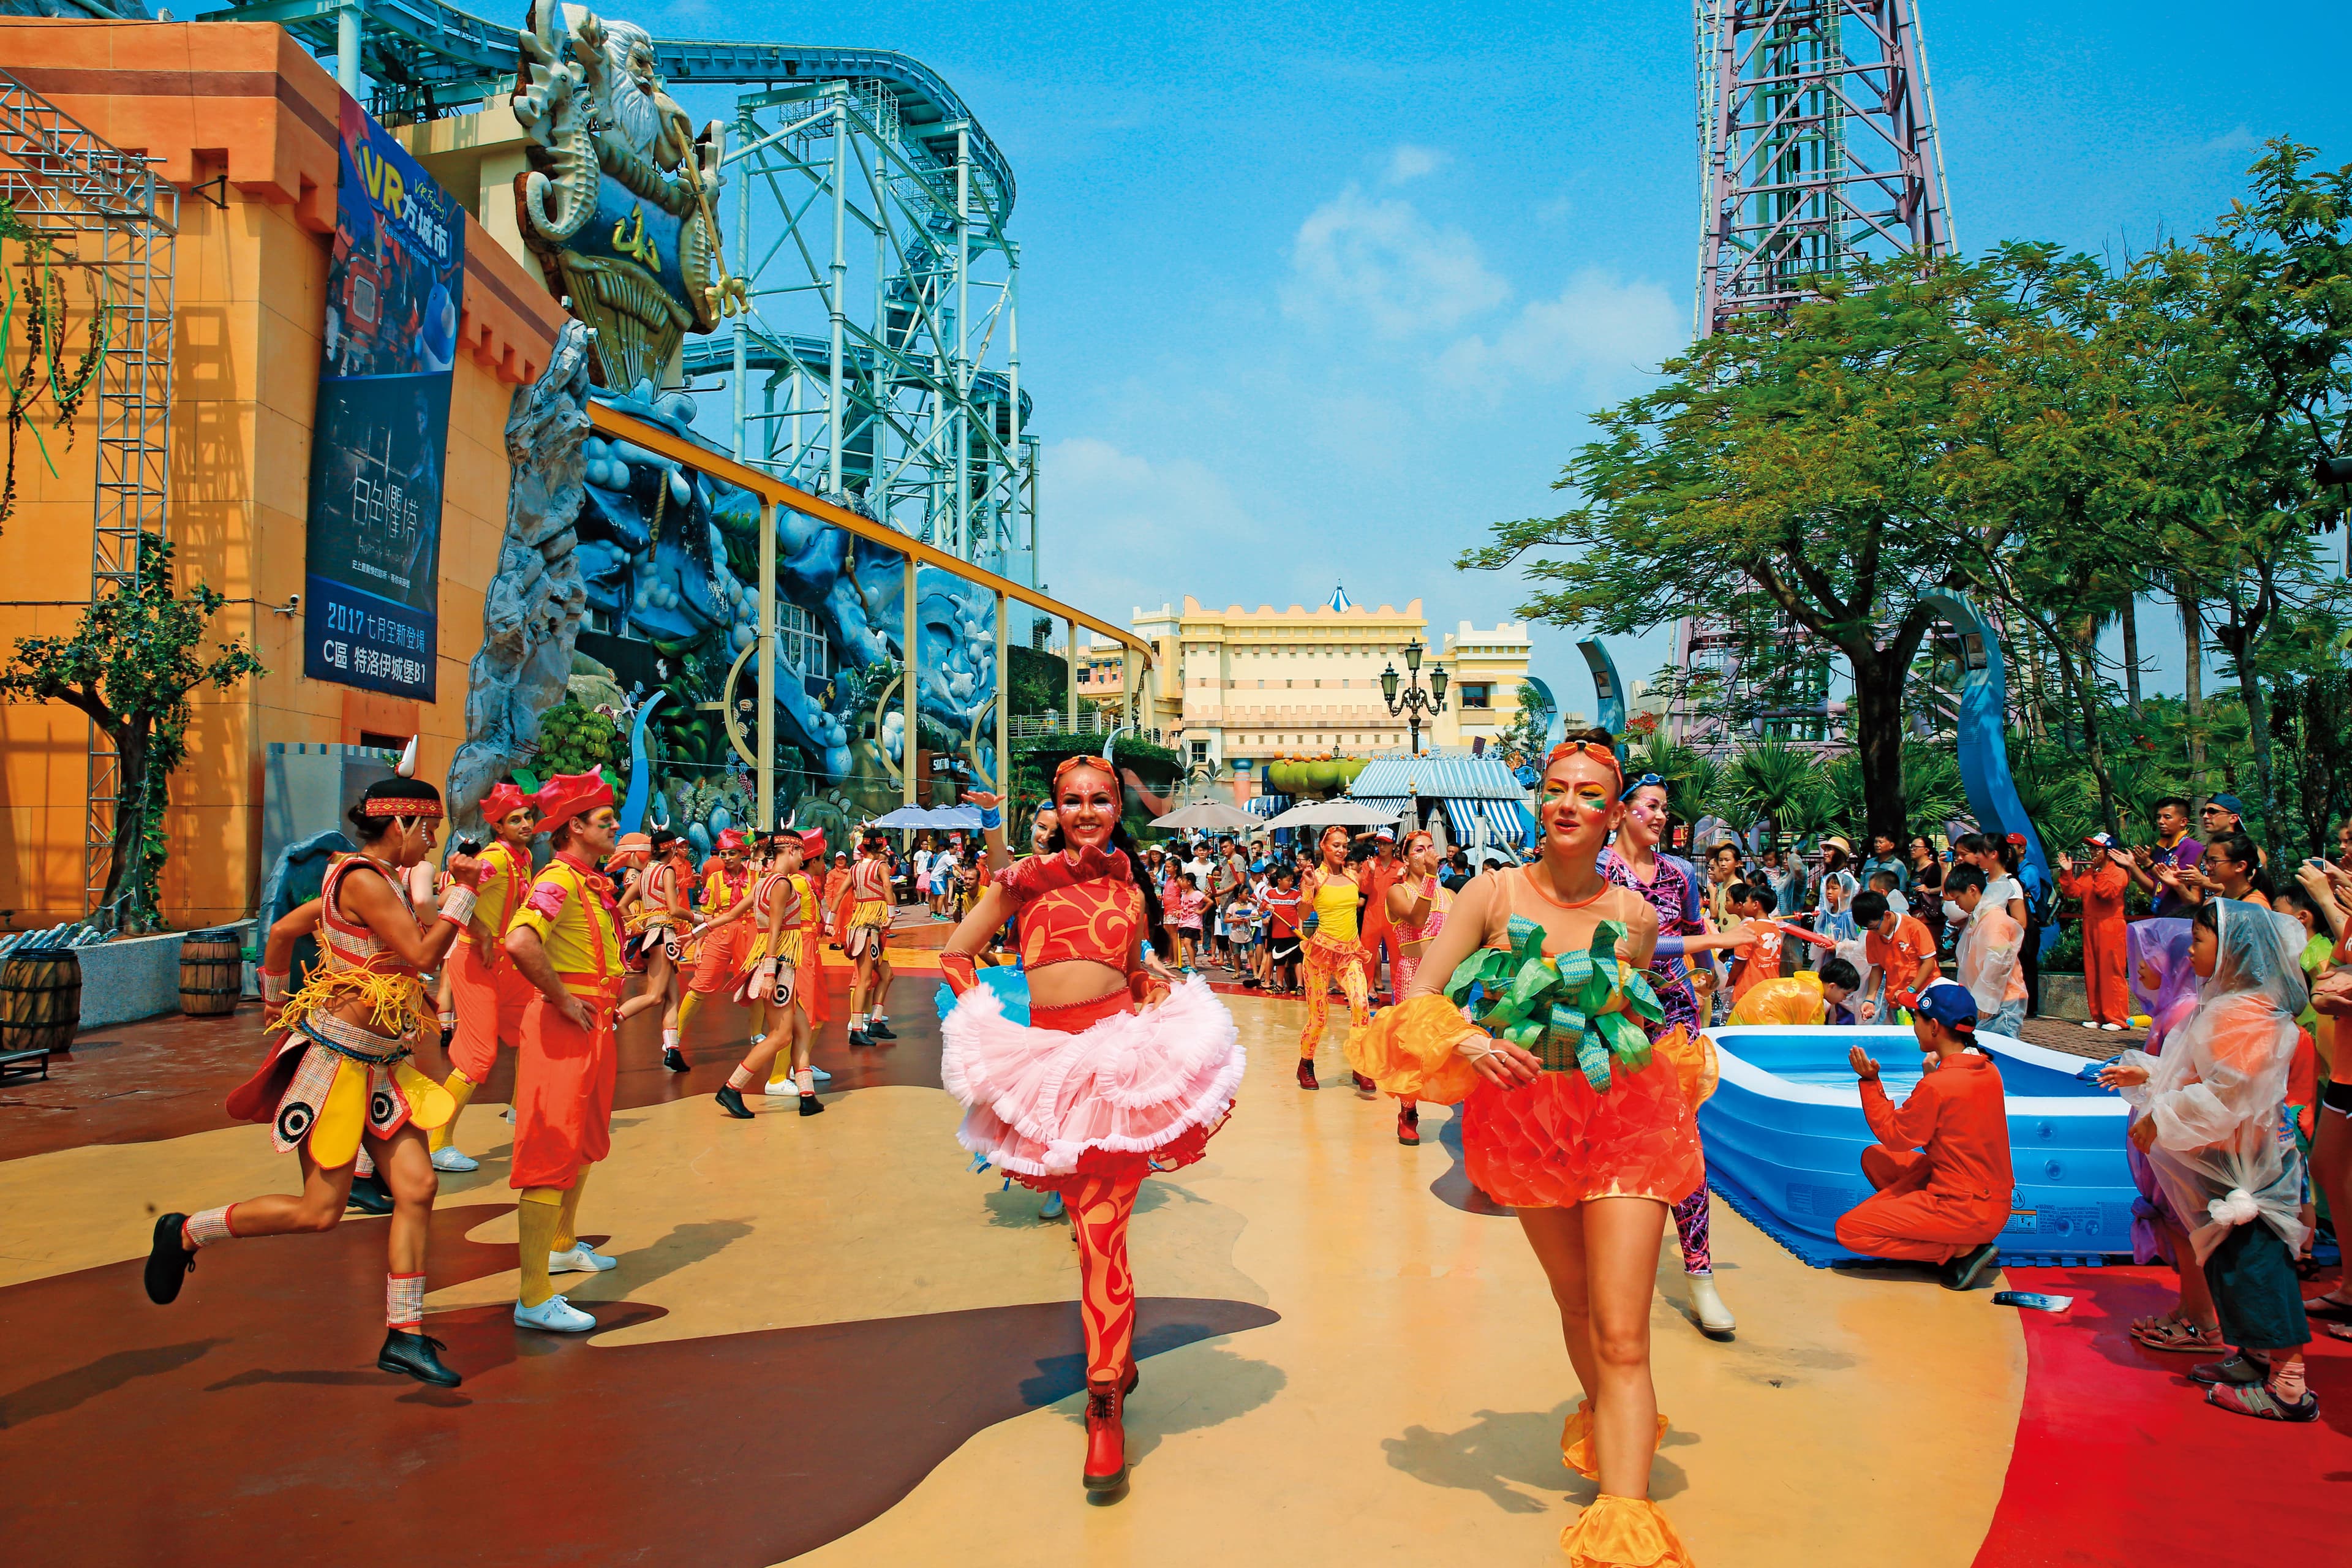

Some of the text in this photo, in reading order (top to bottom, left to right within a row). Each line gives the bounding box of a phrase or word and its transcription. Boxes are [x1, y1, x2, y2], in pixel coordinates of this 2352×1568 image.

[328, 601, 425, 654] 2017 七月全新登場
[323, 639, 426, 685] C區 特洛伊城堡B1
